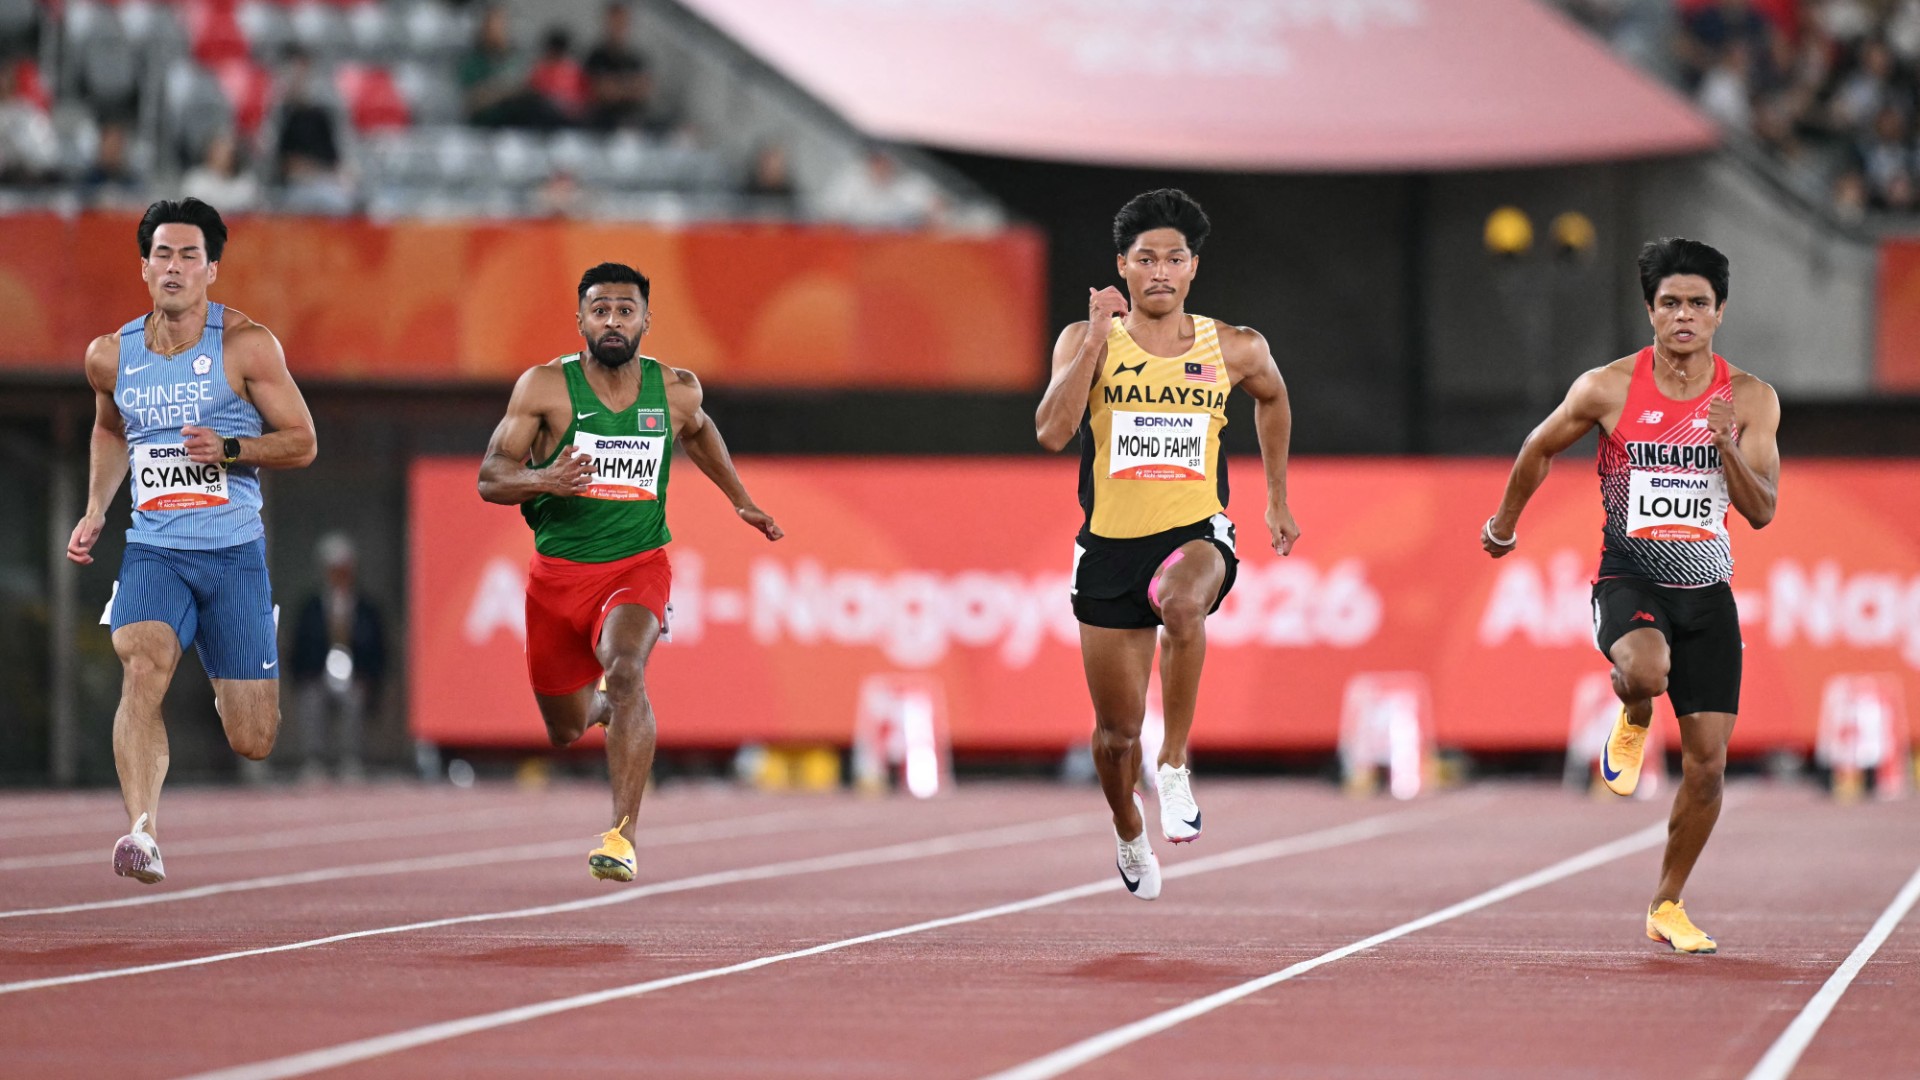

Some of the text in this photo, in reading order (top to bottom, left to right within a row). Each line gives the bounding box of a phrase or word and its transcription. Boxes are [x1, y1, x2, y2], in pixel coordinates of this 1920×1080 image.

[122, 380, 213, 408] CHINESE
[1104, 385, 1224, 409] MALAYSIA
[135, 404, 200, 427] TAIPEI
[1133, 416, 1193, 427] BORNAN
[149, 447, 188, 458] BORN
[595, 439, 650, 450] BORNAN
[1118, 435, 1201, 458] MOHD FAHMI
[580, 458, 657, 479] AHMAN
[1188, 459, 1200, 467] 531
[141, 464, 220, 489] C.YANG
[639, 479, 653, 487] 227
[1650, 478, 1709, 489] BORNAN
[205, 484, 222, 494] 705
[1639, 495, 1712, 519] LOUIS
[1701, 518, 1713, 527] 669
[1205, 560, 1384, 649] 026
